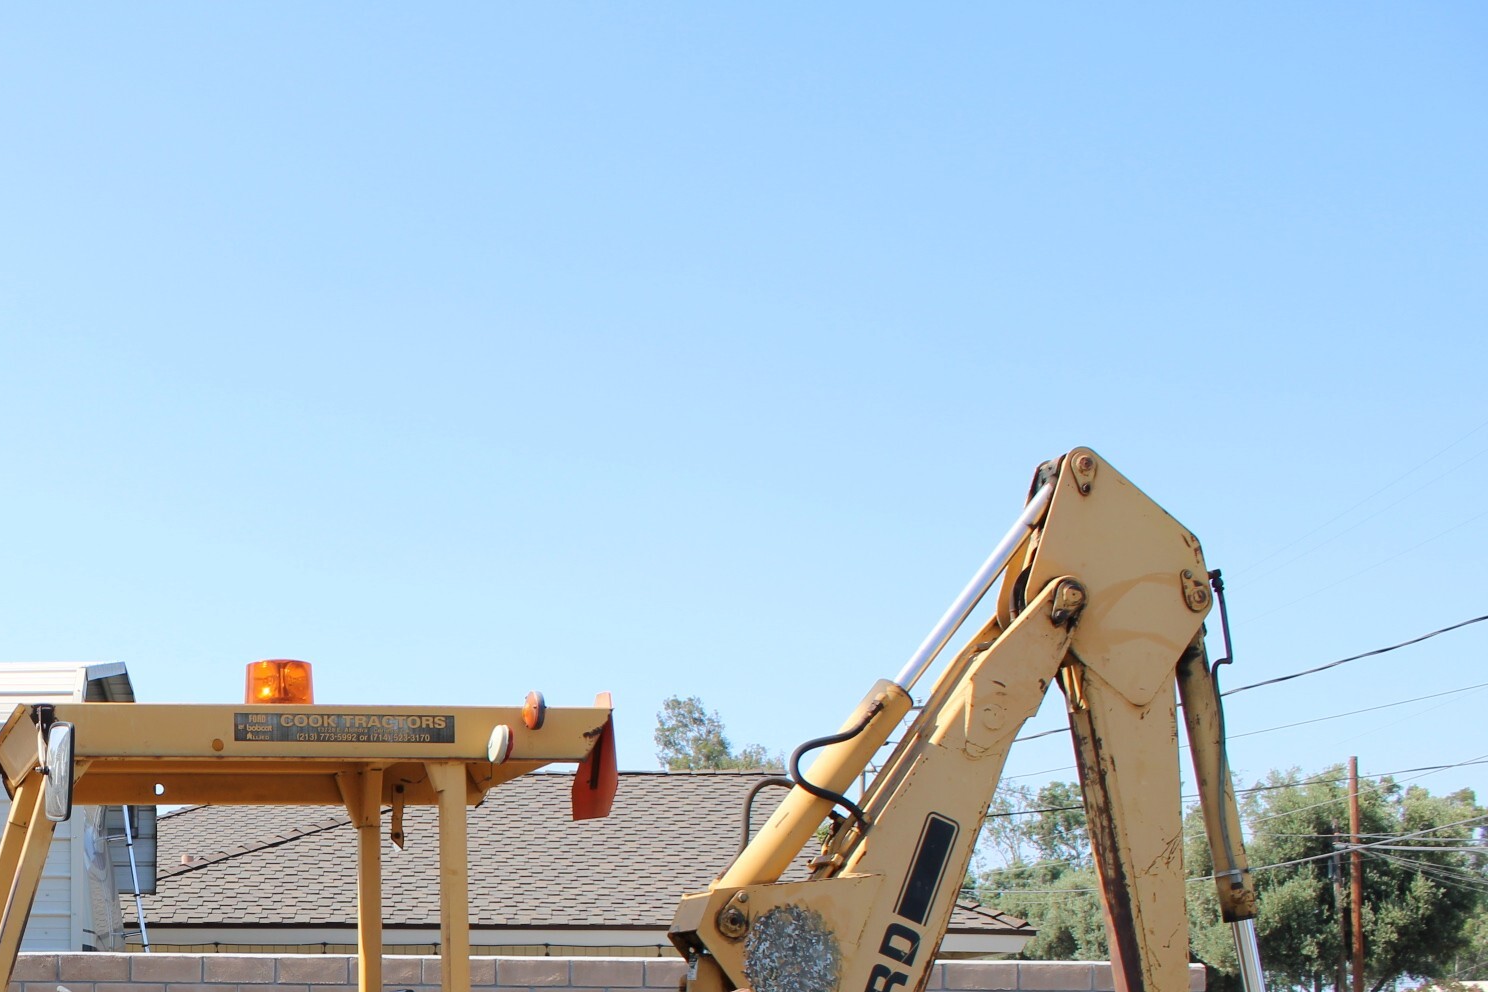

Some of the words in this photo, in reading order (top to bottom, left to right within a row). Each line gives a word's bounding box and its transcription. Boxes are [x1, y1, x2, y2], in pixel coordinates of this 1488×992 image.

[280, 714, 337, 727] COOK
[342, 715, 446, 729] TRACTORS
[246, 723, 273, 732] bobcat
[296, 733, 317, 741] (213)
[320, 733, 357, 741] 773-5992
[370, 734, 391, 742] (714)
[393, 734, 431, 742] 523-3170
